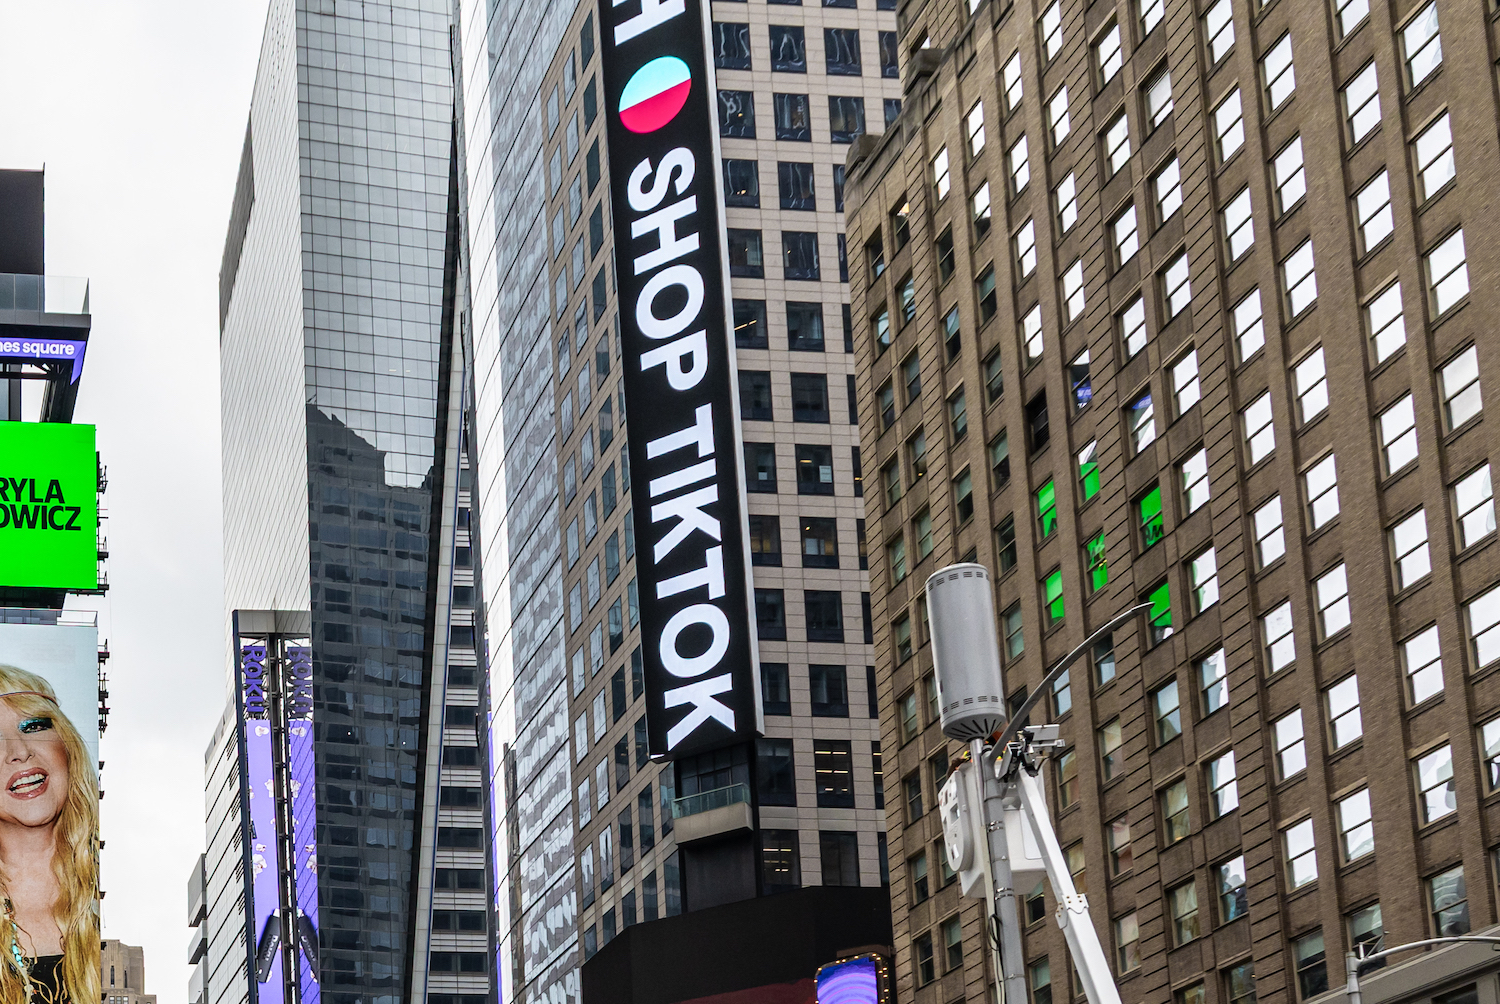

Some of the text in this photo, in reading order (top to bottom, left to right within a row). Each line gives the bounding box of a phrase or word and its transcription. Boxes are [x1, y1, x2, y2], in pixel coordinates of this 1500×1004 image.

[22, 340, 75, 358] square
[627, 147, 736, 751] SHOP TIKTOK
[243, 646, 267, 712] ROKU
